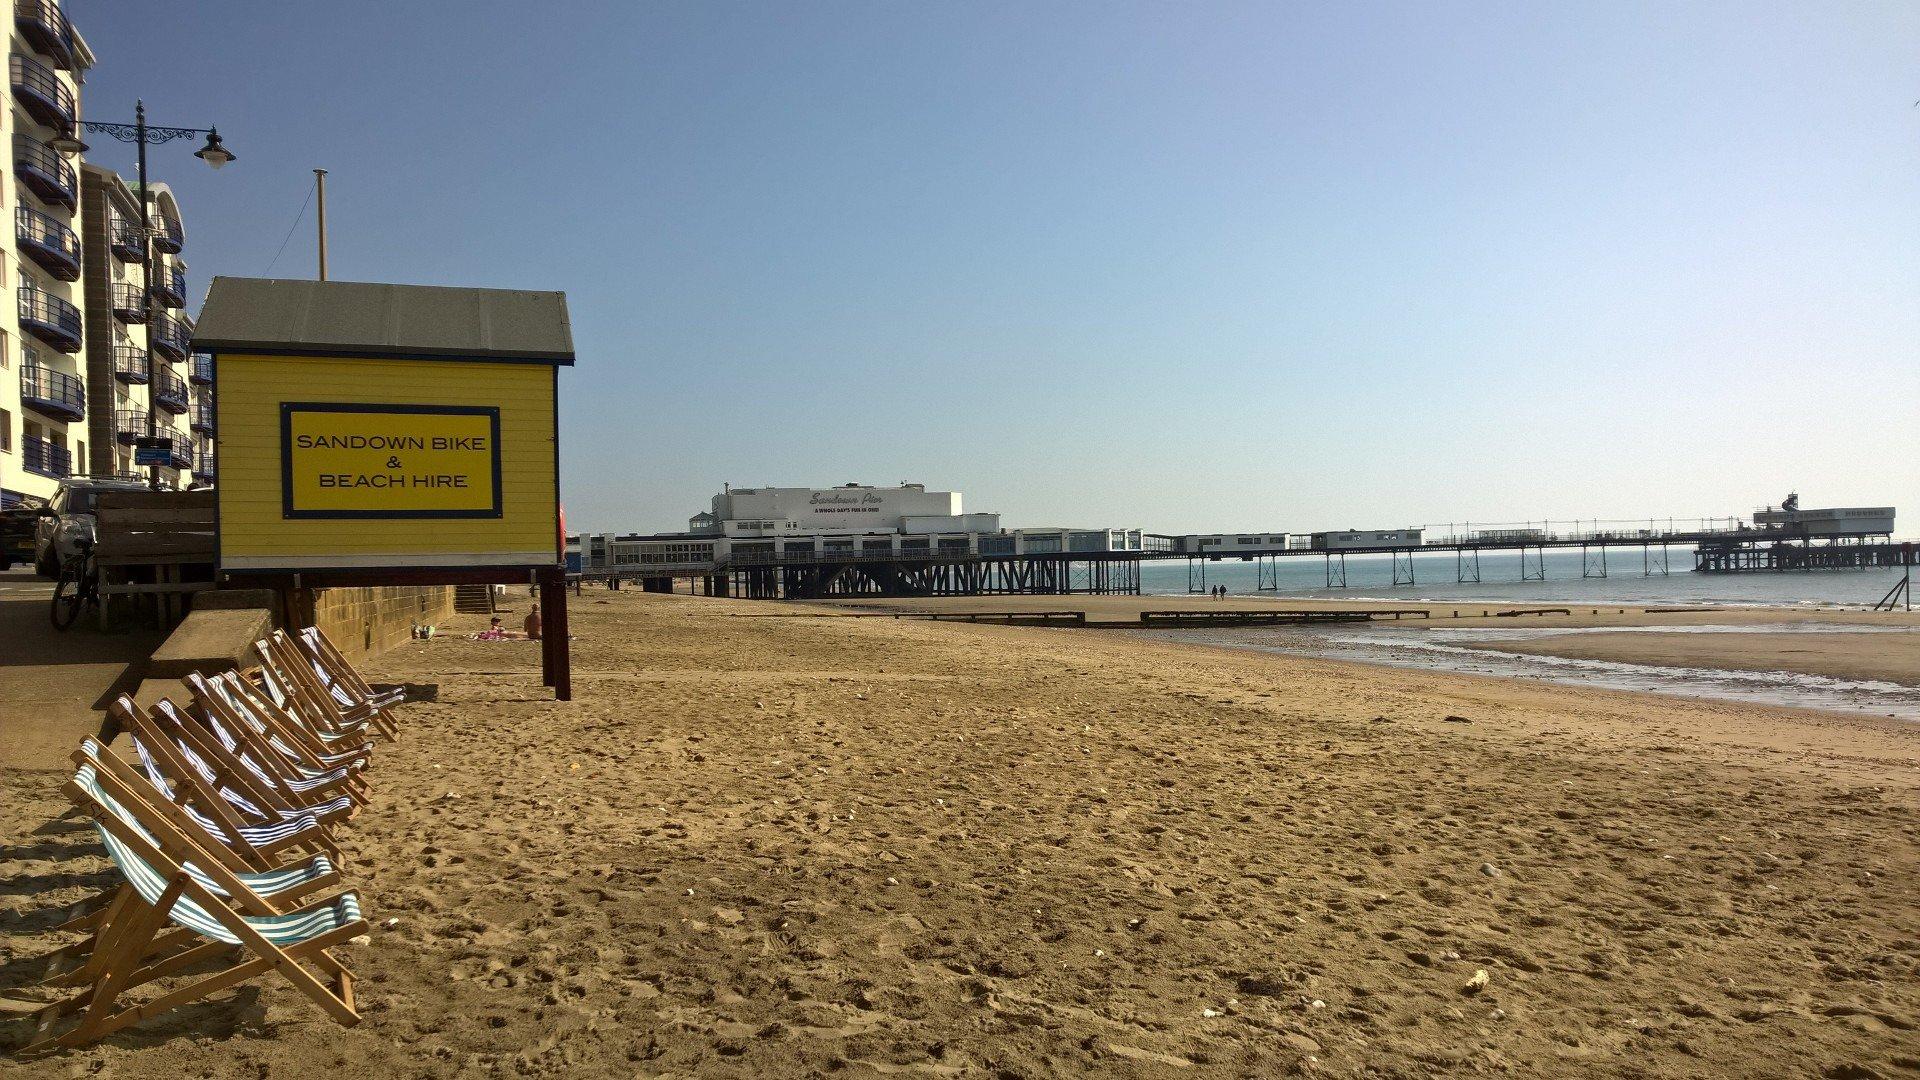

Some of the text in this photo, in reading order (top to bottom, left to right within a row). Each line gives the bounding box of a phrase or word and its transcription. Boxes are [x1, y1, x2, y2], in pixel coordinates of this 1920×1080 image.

[297, 435, 485, 451] SANDOWN BIKE
[386, 455, 402, 468] &
[319, 474, 468, 488] BEACH HIRE
[809, 493, 883, 504] Sandown Pier
